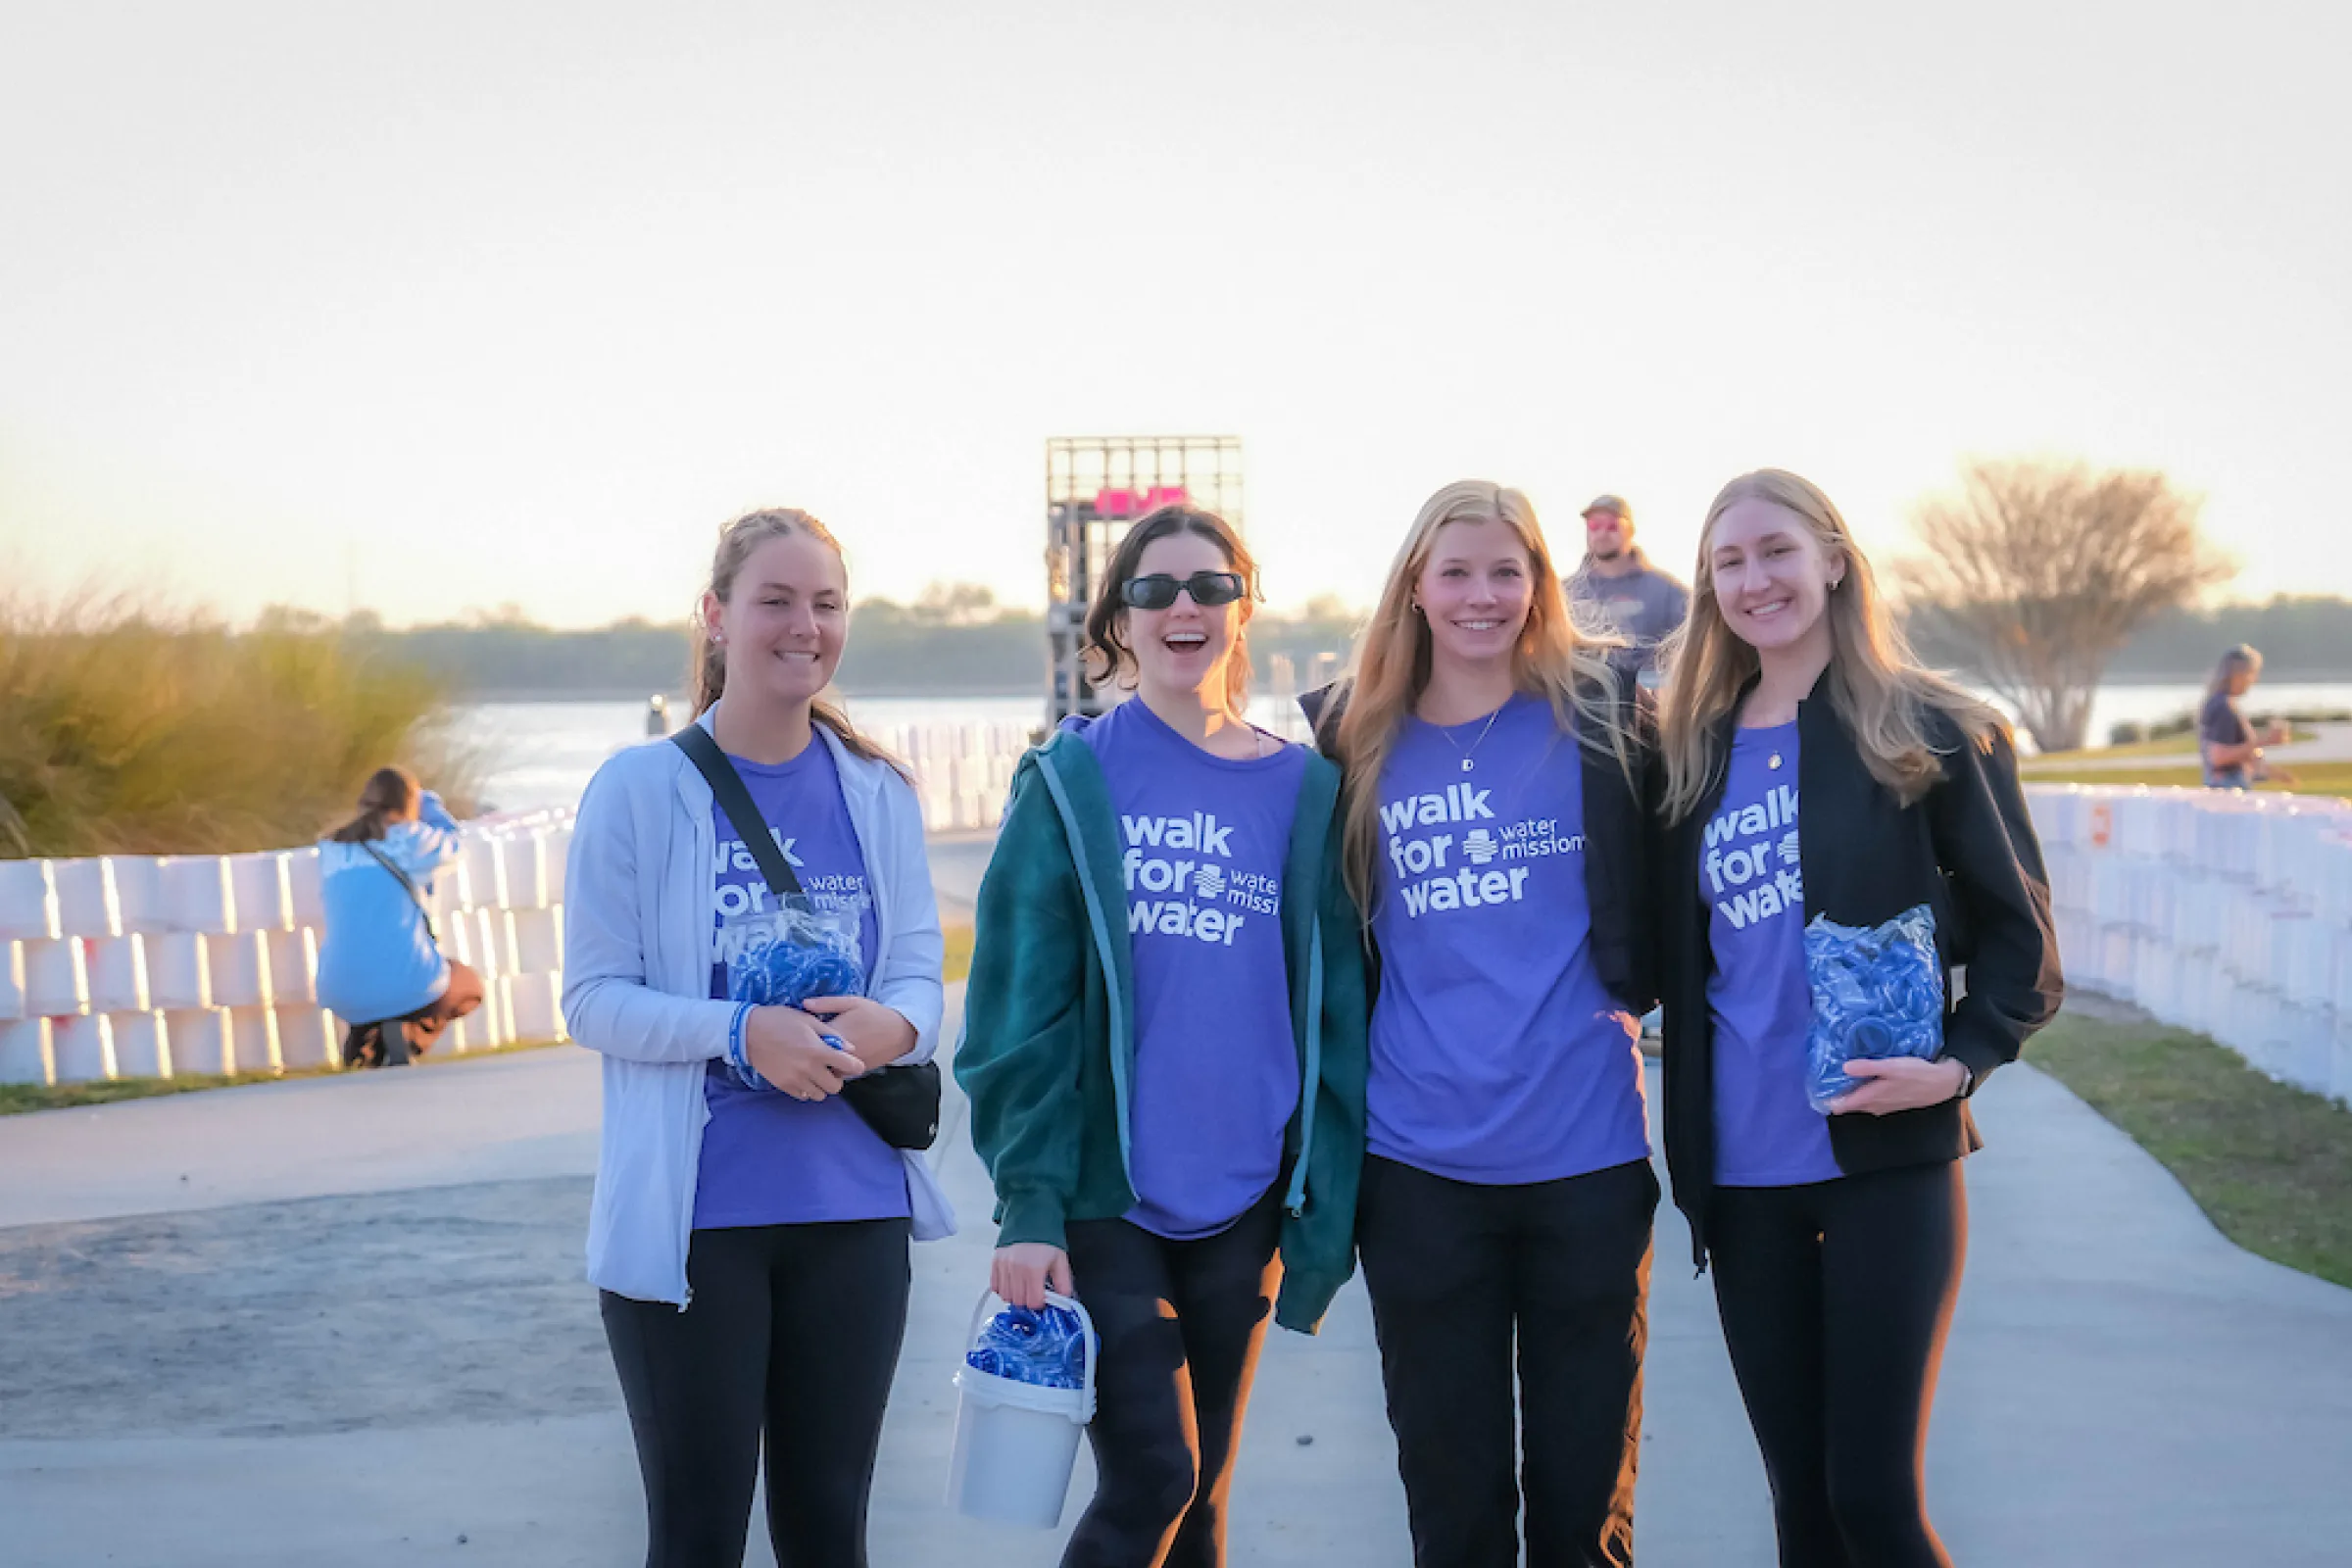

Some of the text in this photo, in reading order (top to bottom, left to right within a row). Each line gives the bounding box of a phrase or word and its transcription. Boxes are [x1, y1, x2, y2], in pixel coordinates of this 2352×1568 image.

[1380, 783, 1494, 834] walk
[1497, 817, 1557, 841] water
[1122, 810, 1234, 858] walk
[1390, 834, 1452, 879] for
[1502, 835, 1584, 860] mission
[1122, 848, 1195, 892] for
[1230, 868, 1278, 895] wate
[1705, 841, 1771, 893] for
[715, 881, 767, 916] or
[1227, 888, 1278, 915] missi
[1401, 866, 1530, 918] water
[1717, 868, 1803, 929] wate
[1128, 897, 1245, 946] water
